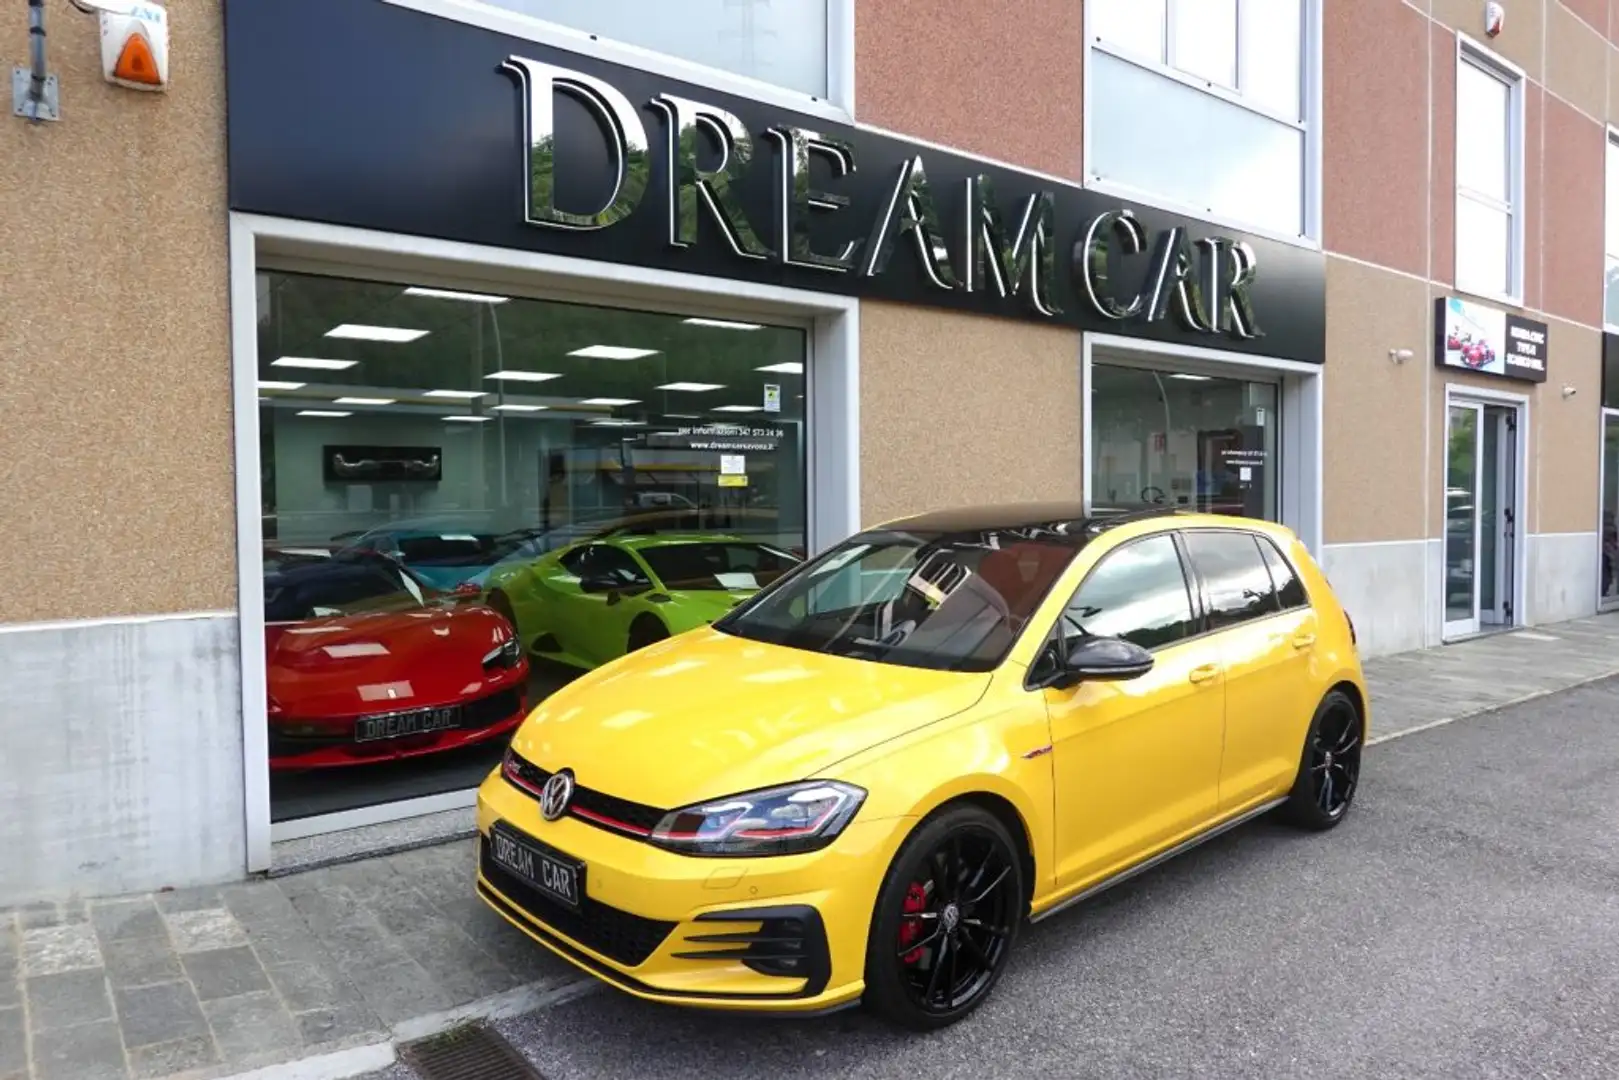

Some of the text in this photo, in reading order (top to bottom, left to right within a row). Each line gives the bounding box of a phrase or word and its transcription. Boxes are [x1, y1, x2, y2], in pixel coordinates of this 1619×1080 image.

[499, 54, 1267, 339] DREAM CAR
[366, 709, 452, 738] DREAM CAR
[495, 833, 571, 897] DREAM CAR
